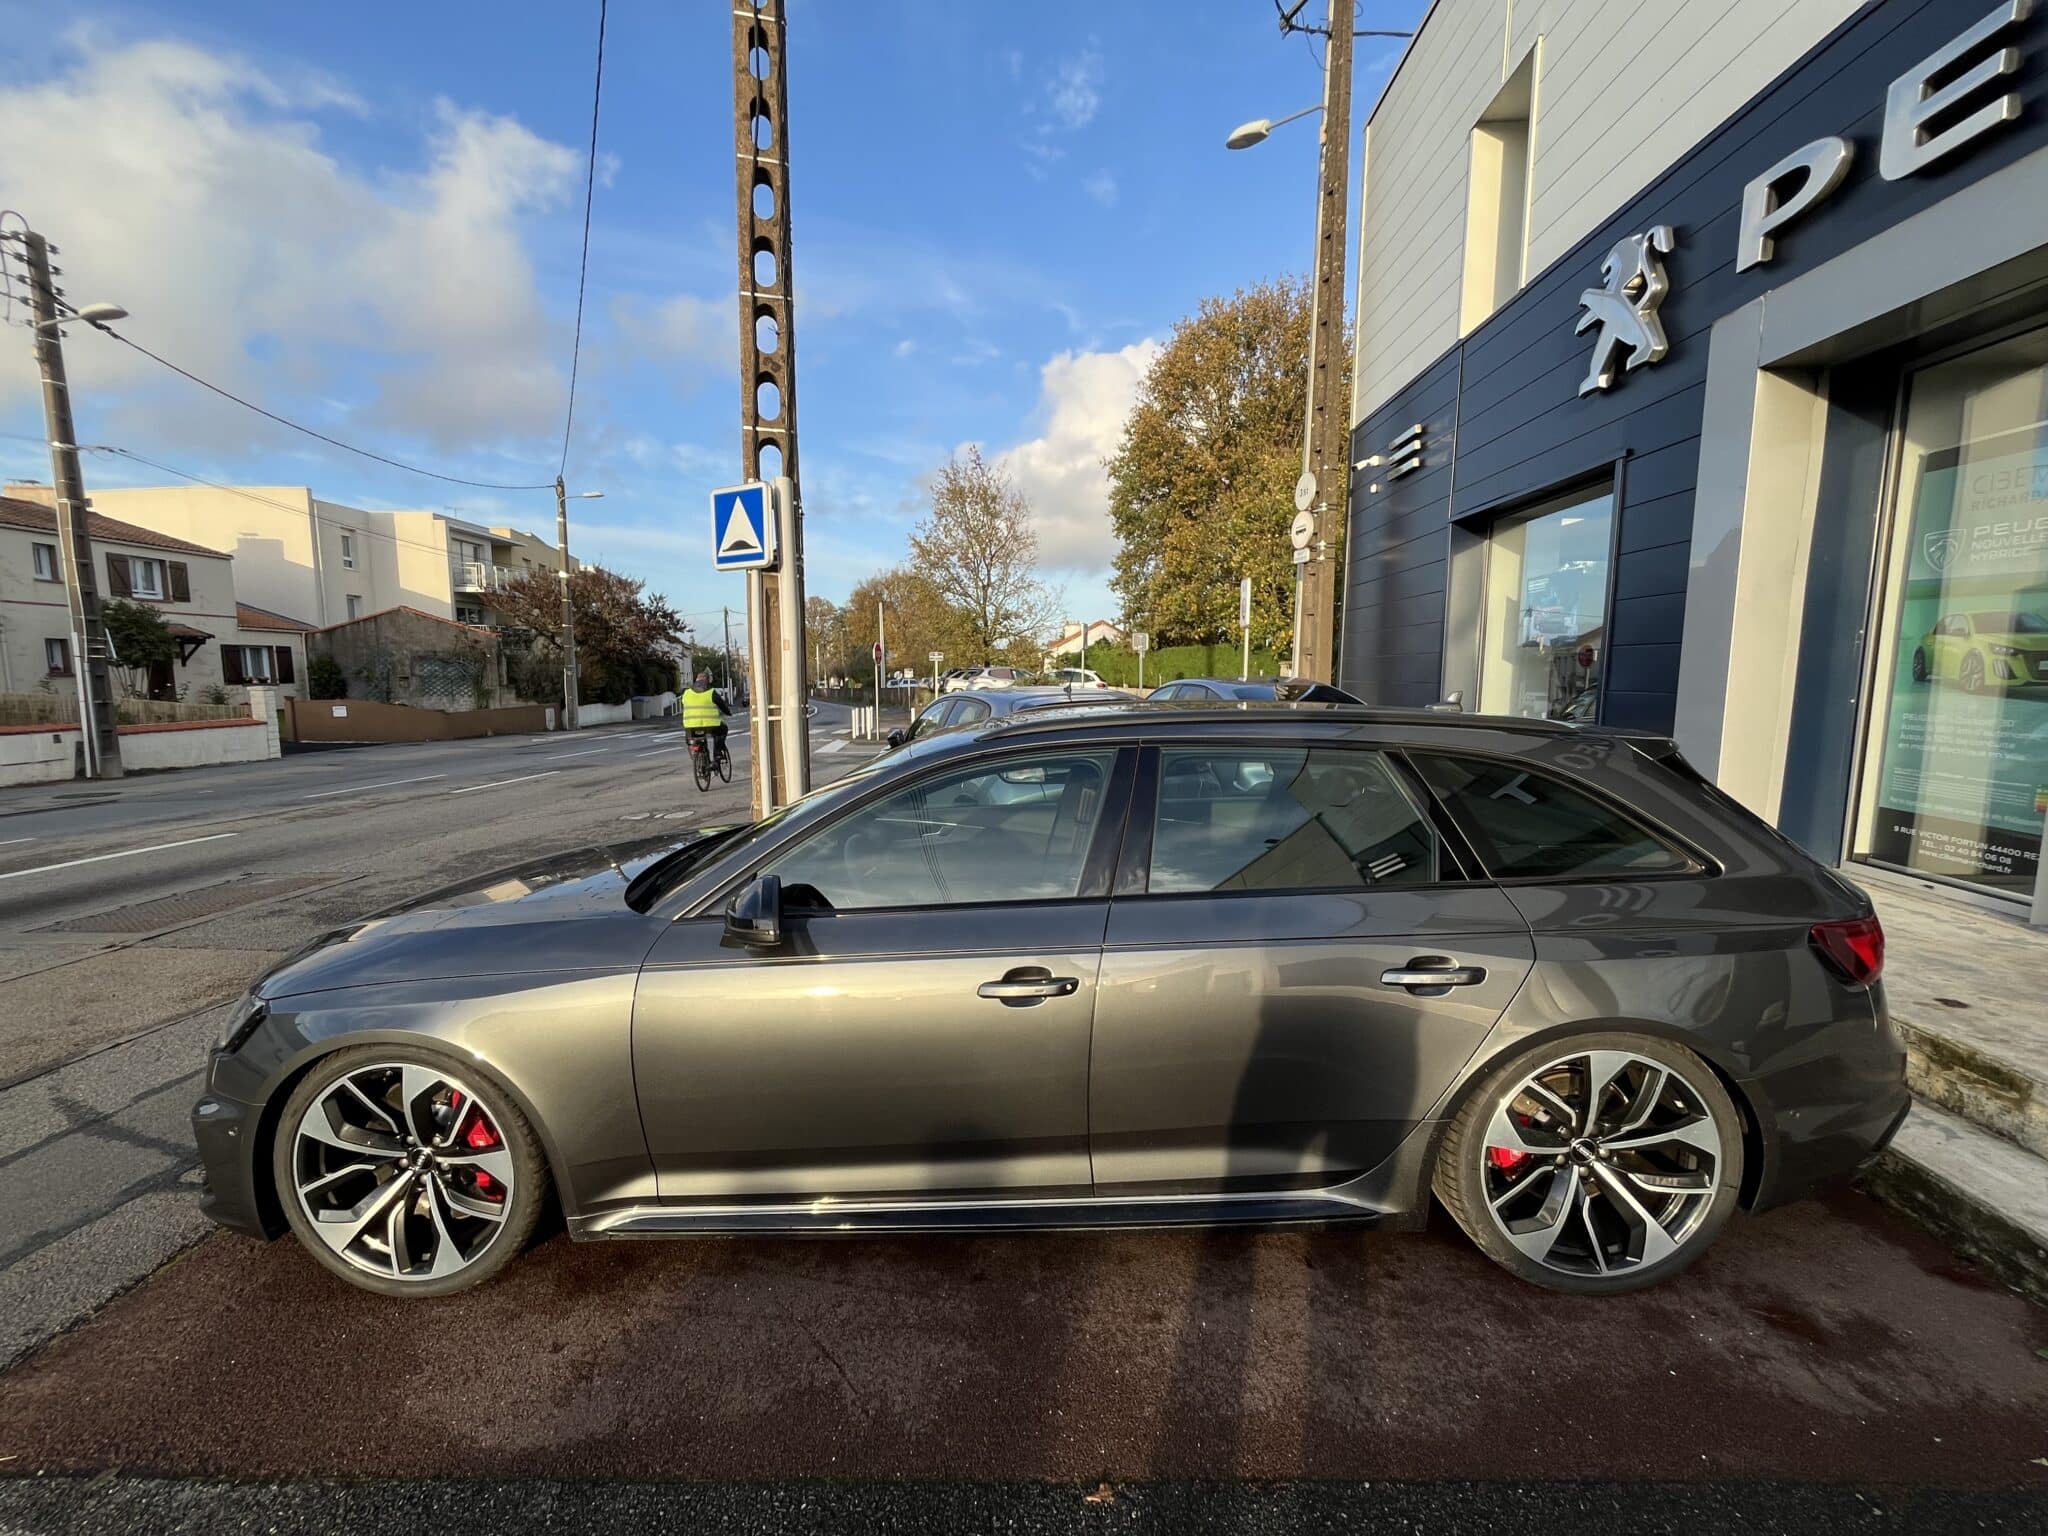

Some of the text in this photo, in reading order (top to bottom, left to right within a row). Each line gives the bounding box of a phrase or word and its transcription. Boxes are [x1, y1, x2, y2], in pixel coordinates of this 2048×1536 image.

[1901, 826, 1917, 836] RUE
[1920, 830, 1949, 842] VICTOR
[1951, 837, 1988, 850] FORTUN
[1990, 845, 2021, 857] 44400
[1944, 844, 1956, 853] 02
